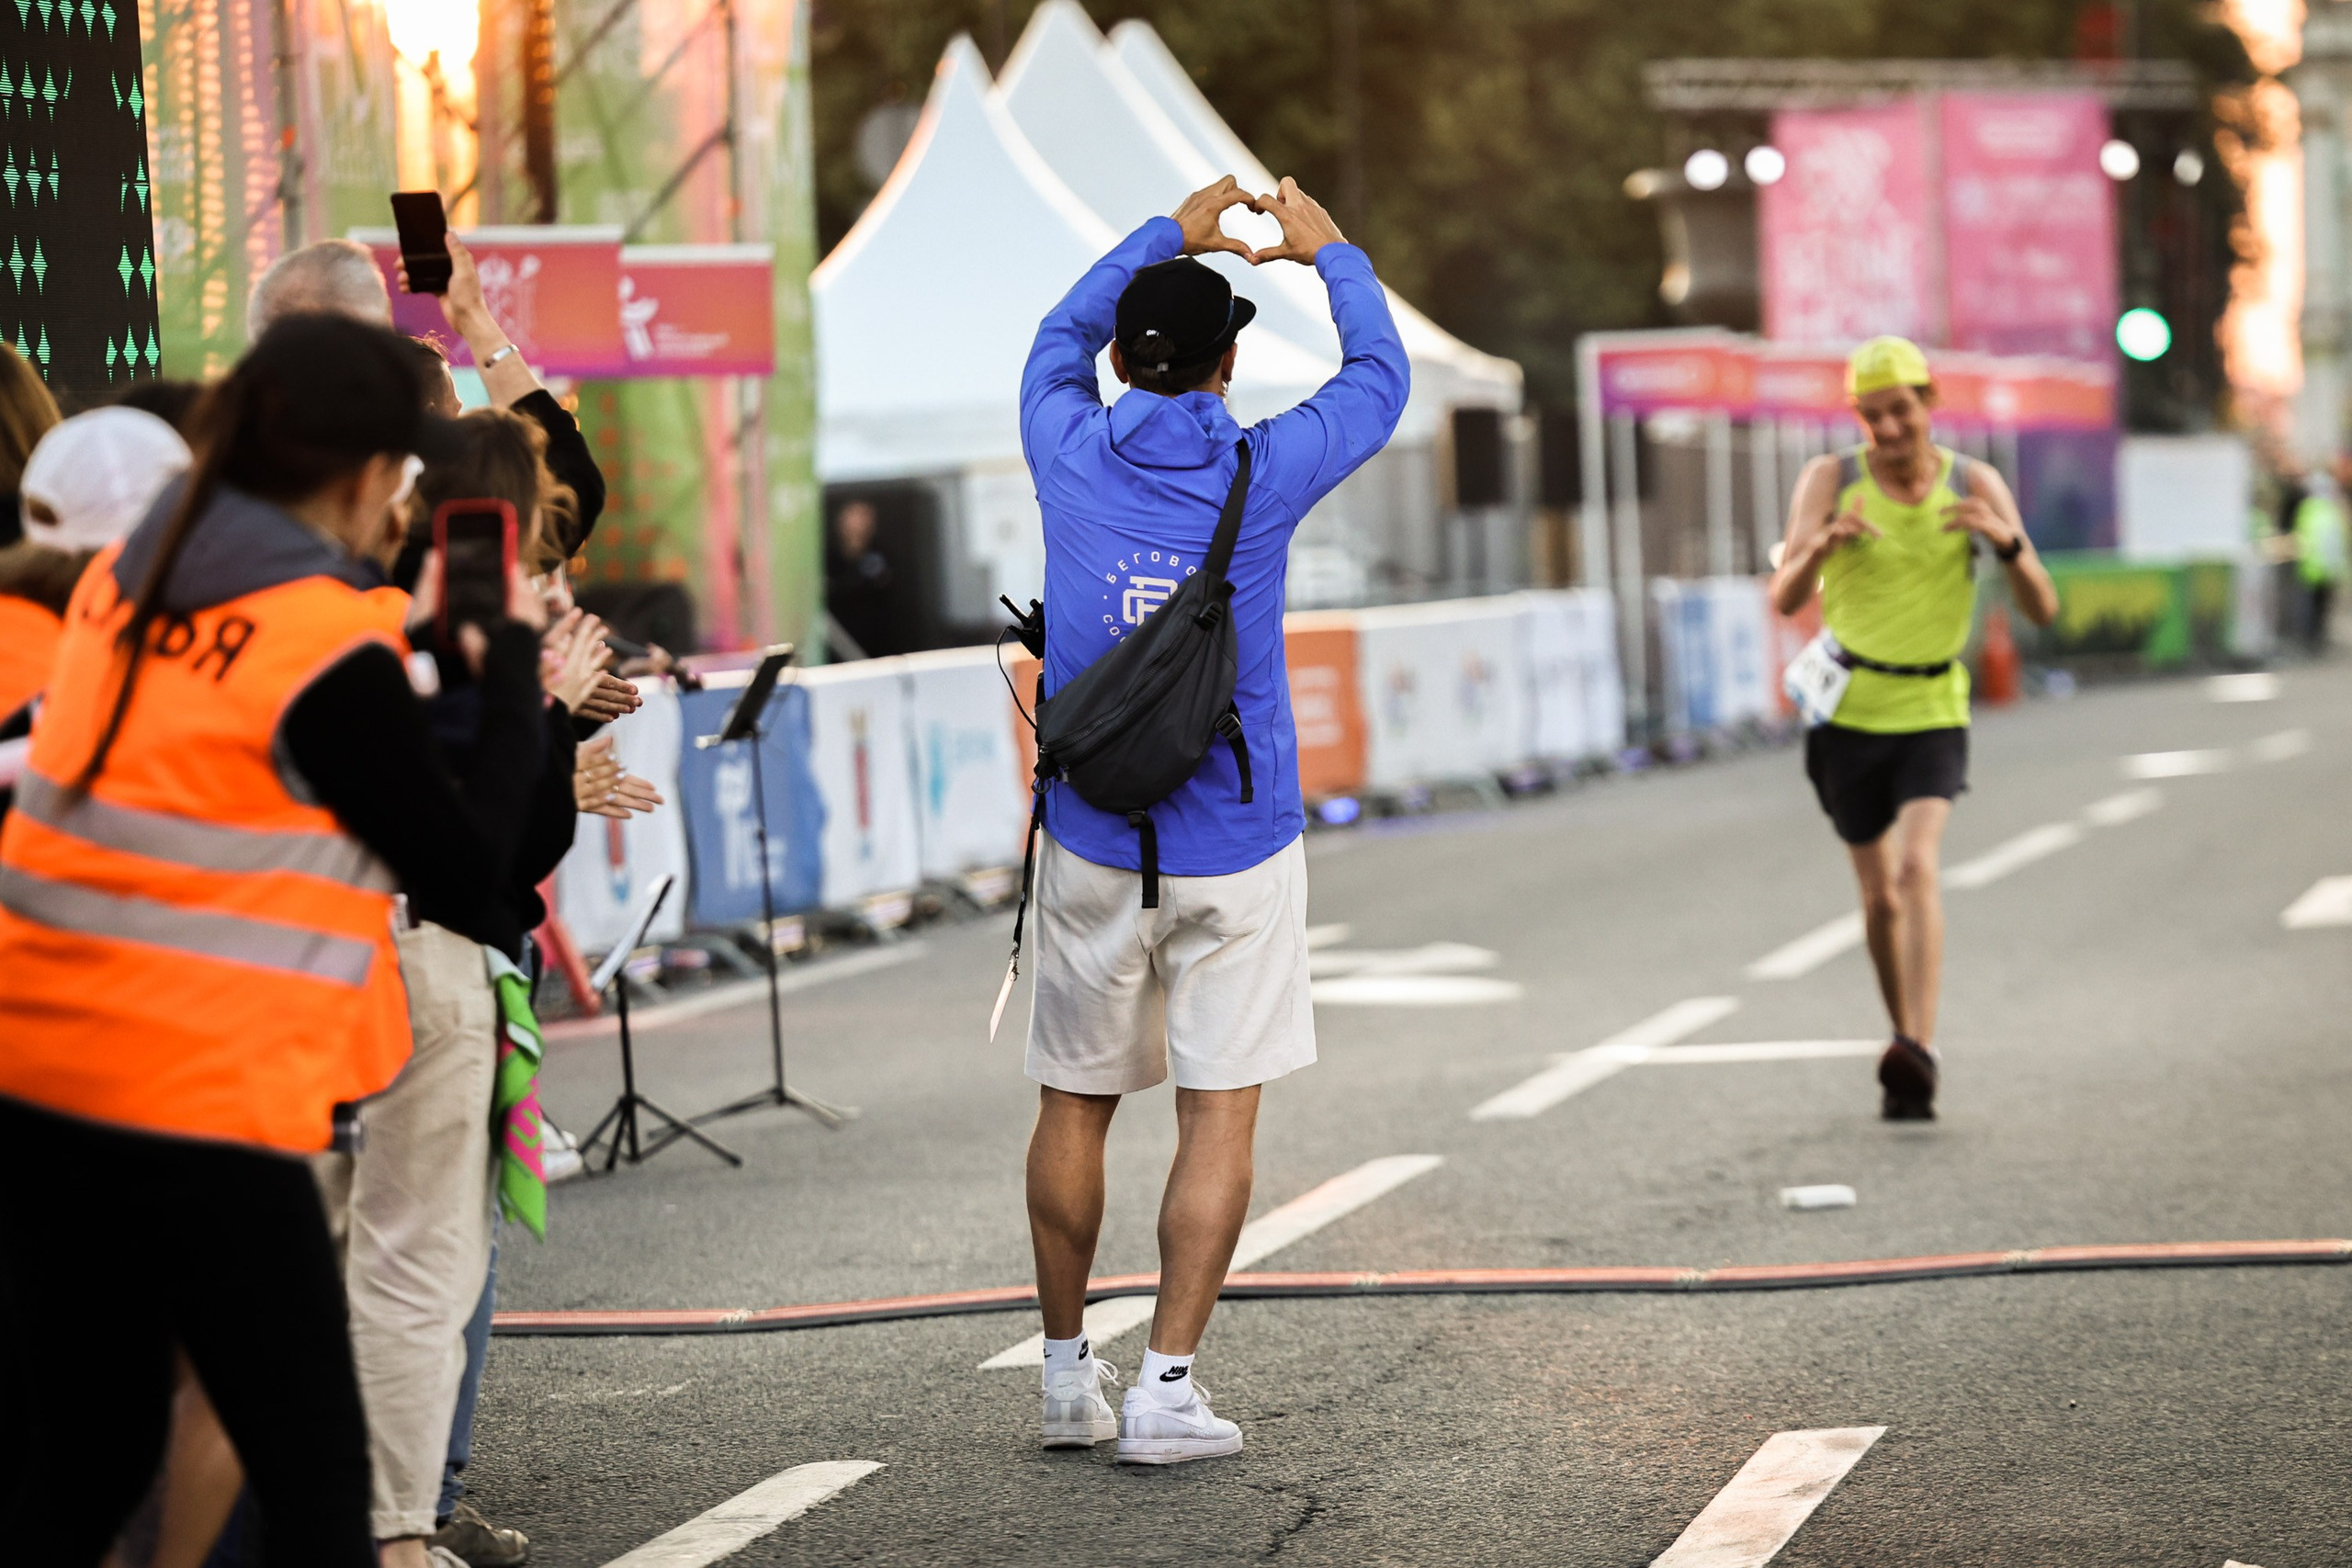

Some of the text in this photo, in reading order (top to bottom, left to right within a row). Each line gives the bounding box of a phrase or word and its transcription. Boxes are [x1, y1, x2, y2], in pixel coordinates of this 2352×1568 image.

[1105, 550, 1197, 585] БЕГОВО
[1102, 614, 1127, 644] СО
[1168, 1365, 1189, 1375] NIKE
